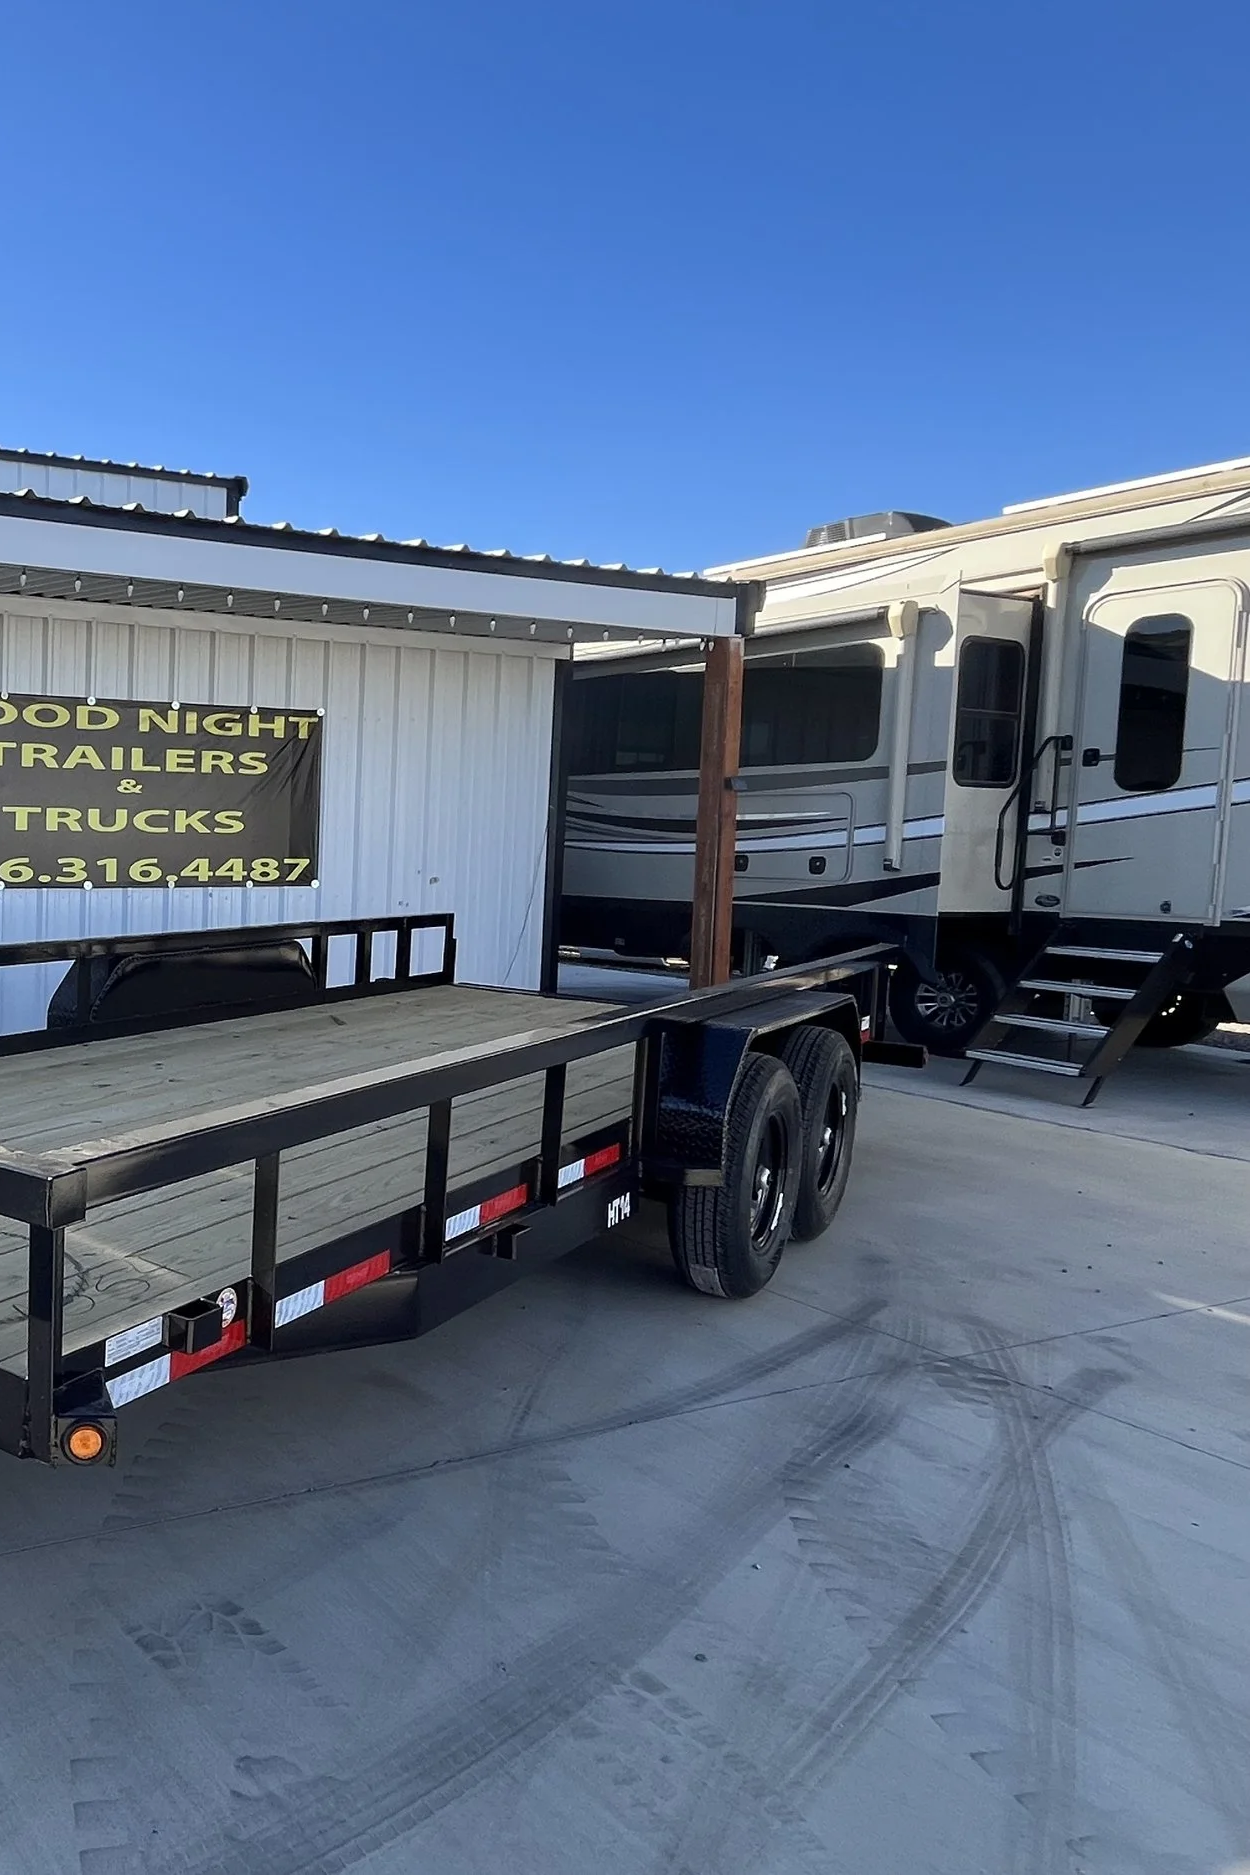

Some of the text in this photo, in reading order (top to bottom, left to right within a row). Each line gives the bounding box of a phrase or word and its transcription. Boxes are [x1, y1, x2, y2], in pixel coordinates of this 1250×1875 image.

[138, 709, 319, 740] NIGHT
[116, 778, 143, 794] &
[2, 806, 245, 834] TRUCKS
[607, 1191, 630, 1228] HT14
